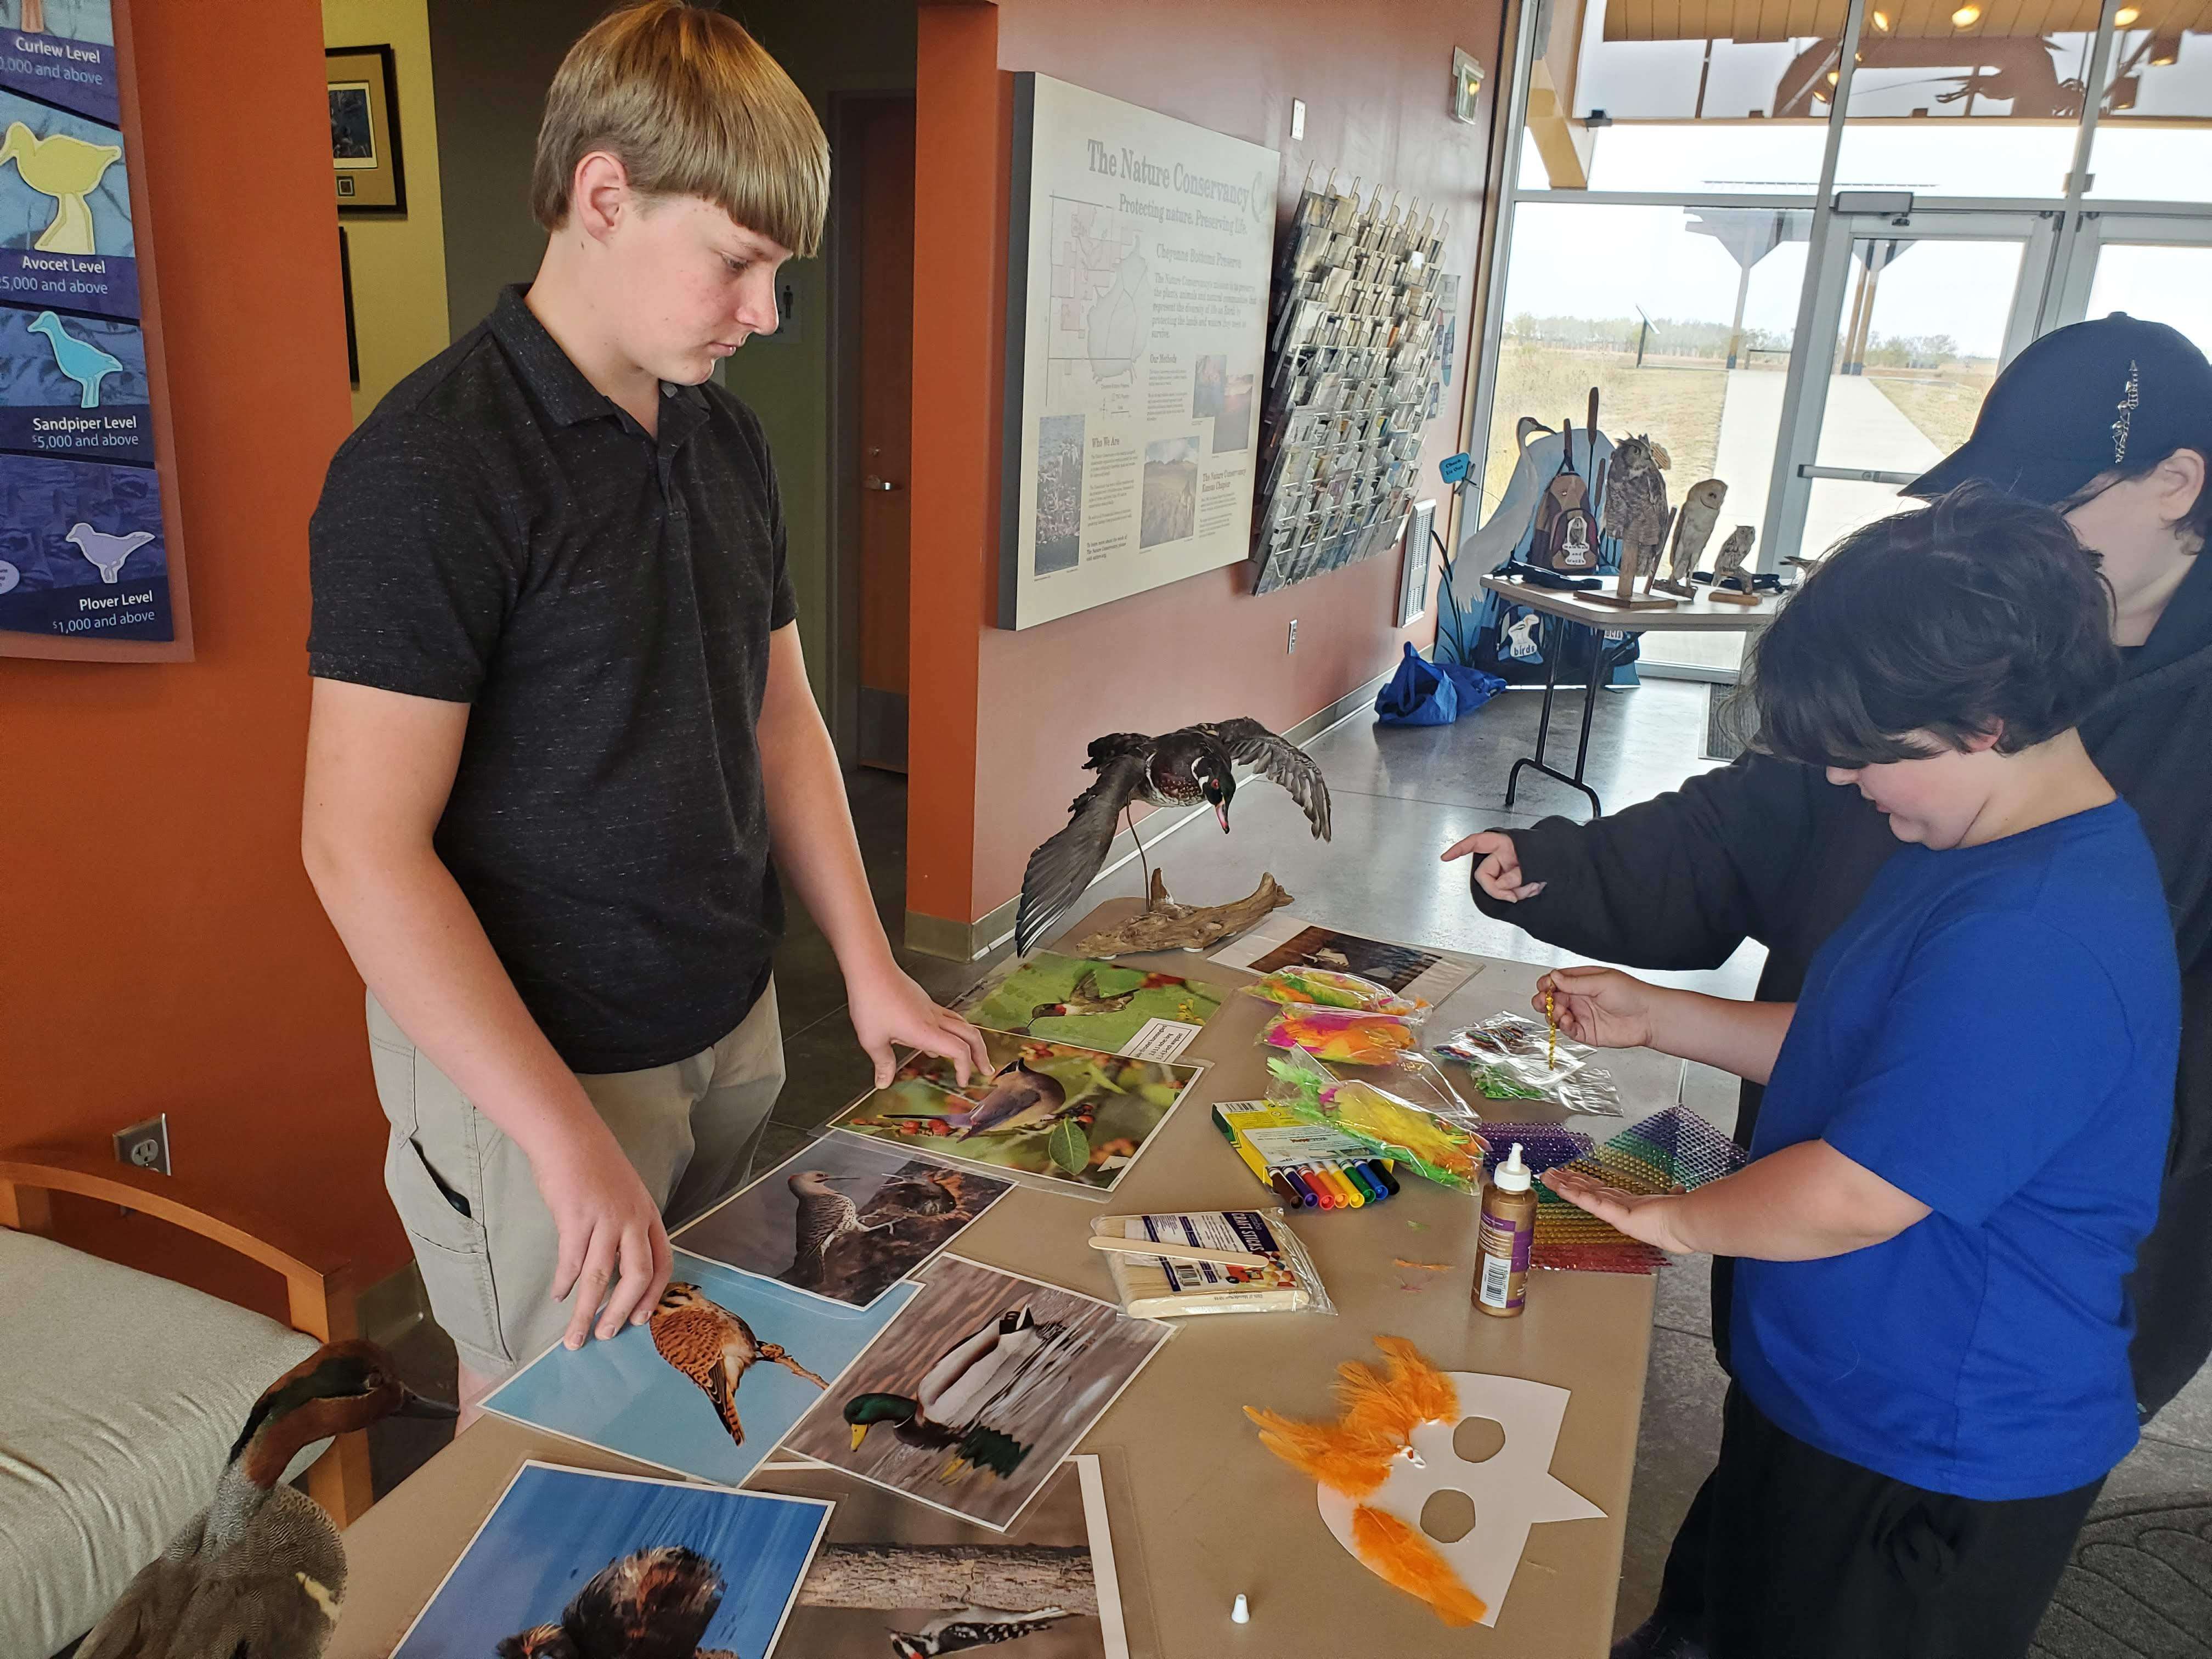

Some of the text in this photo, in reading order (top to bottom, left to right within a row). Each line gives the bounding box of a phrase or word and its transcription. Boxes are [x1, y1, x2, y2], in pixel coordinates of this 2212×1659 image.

[16, 36, 101, 64] Curlew Level
[35, 64, 61, 79] and
[63, 67, 103, 86] above
[1087, 138, 1250, 213] The Nature Conservancy
[1119, 193, 1248, 236] Protecting nature. Preserving life.
[22, 255, 106, 274] Avocet Level
[0, 276, 109, 295] 5,000 and above
[32, 415, 137, 433] Sandpiper Level
[32, 432, 139, 450] $5,000 and above
[1092, 436, 1120, 448] Who We Are
[79, 589, 154, 611] Plover Level
[52, 611, 155, 634] $1,000 and above
[1514, 645, 1536, 656] birds
[1231, 1212, 1265, 1251] CRAFT STICKS
